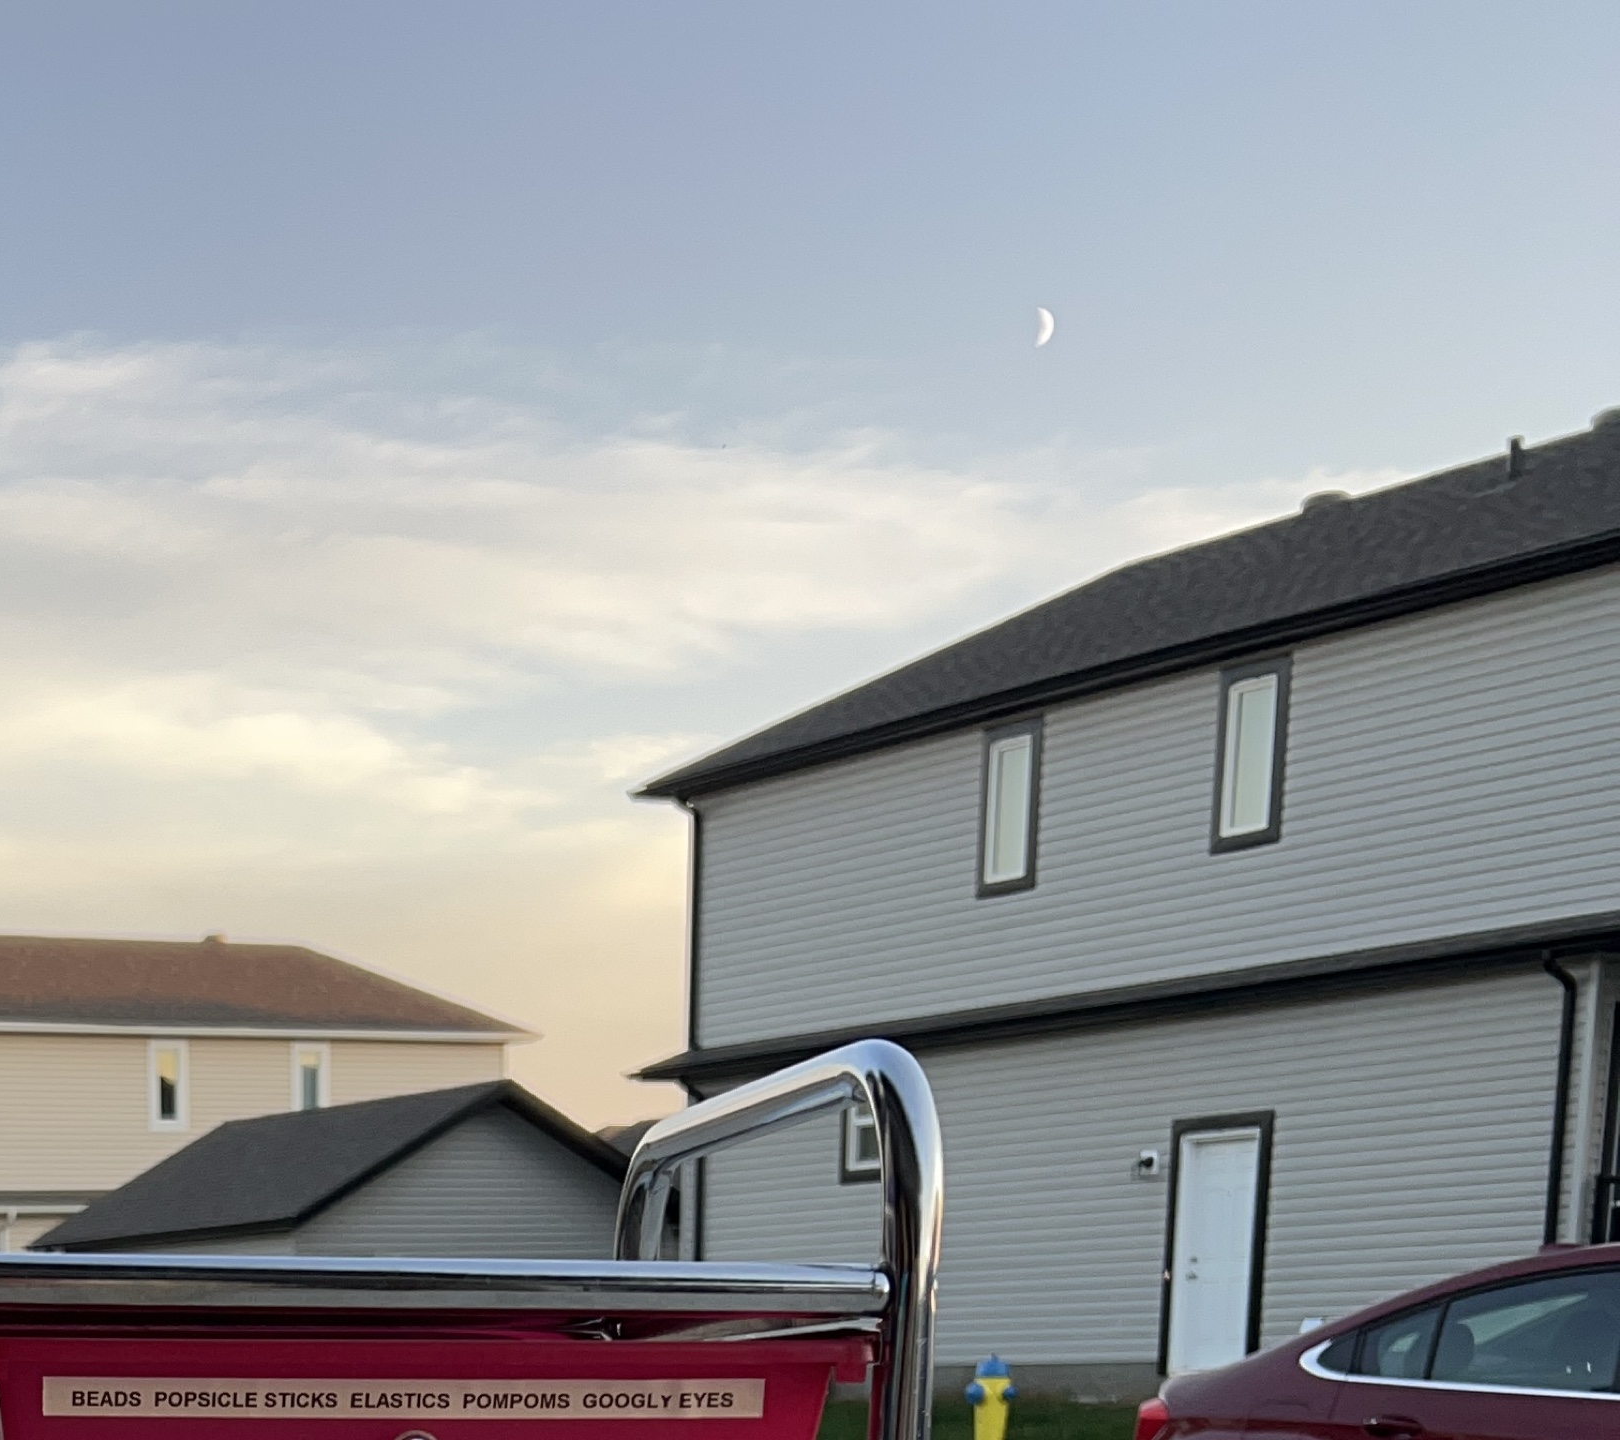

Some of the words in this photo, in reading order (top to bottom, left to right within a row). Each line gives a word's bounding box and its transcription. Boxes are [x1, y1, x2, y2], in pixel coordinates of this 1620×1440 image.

[71, 1390, 142, 1407] BEADS
[154, 1391, 258, 1408] POPSICLE
[264, 1392, 338, 1409] STICKS
[350, 1392, 450, 1409] ELASTICS
[462, 1393, 570, 1410] POMPOMS
[678, 1392, 734, 1409] EYES
